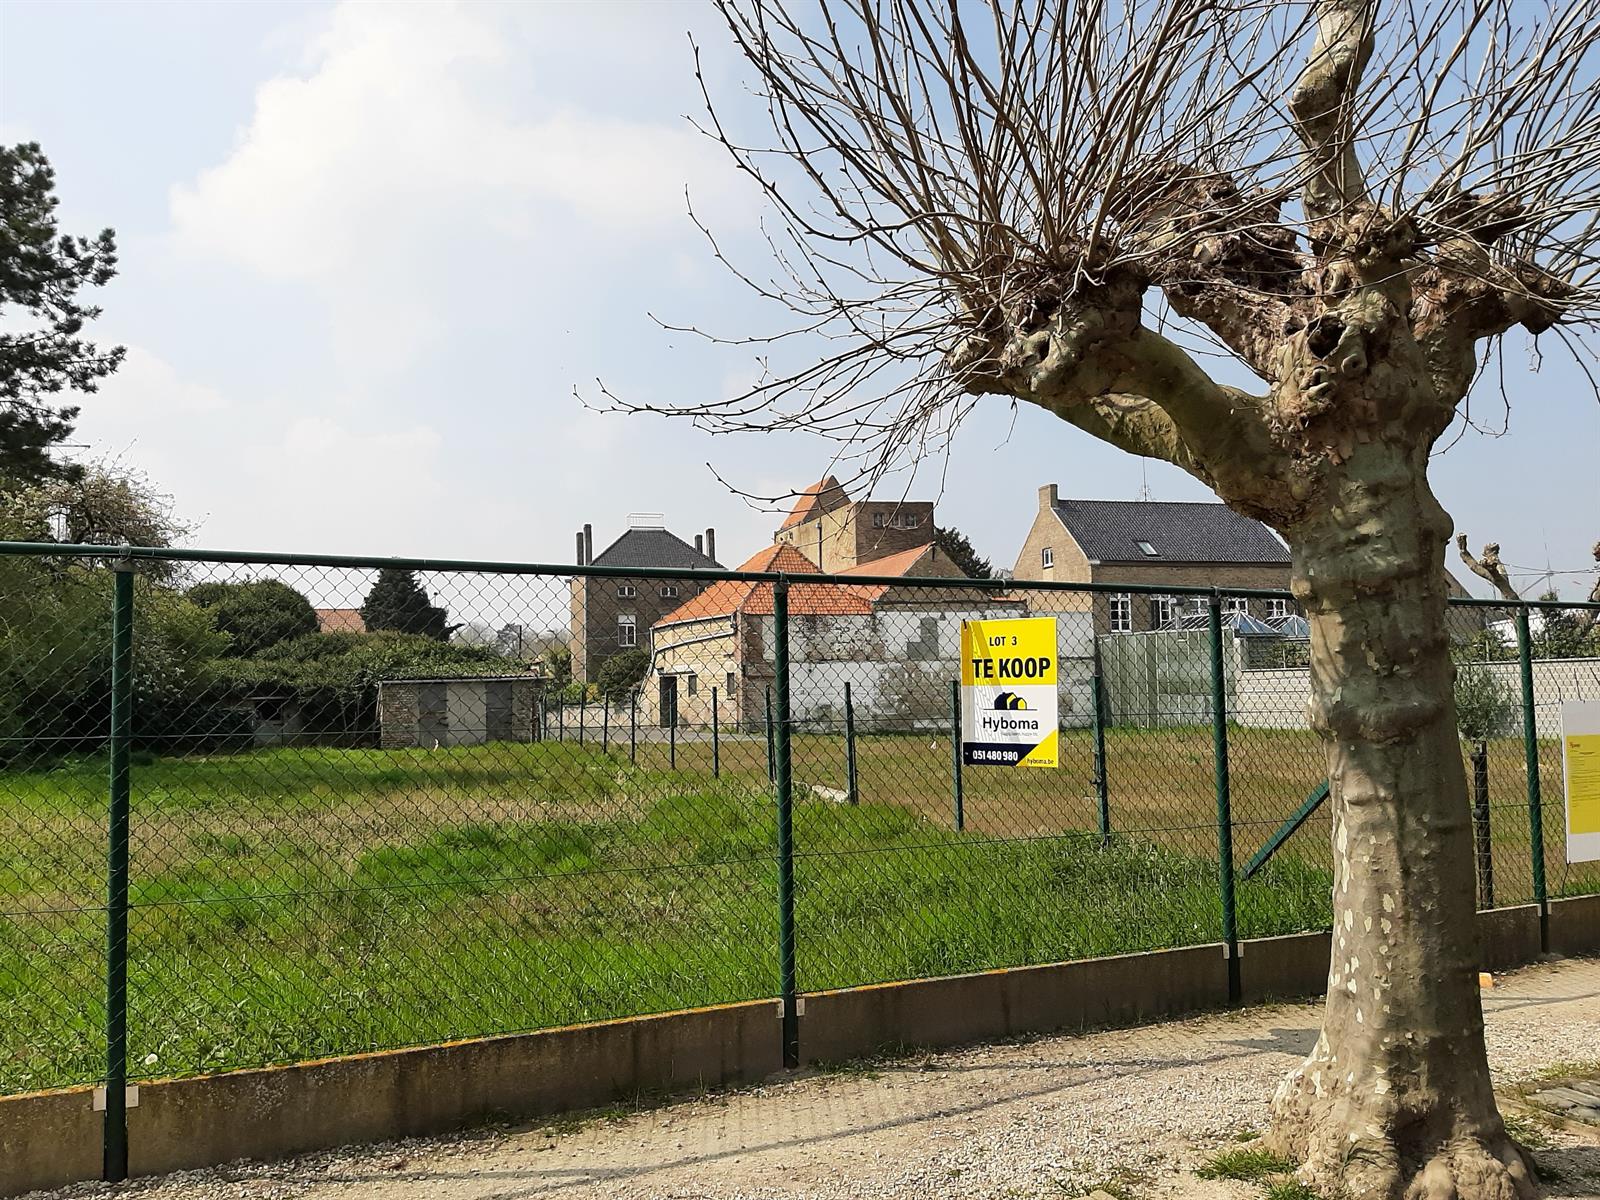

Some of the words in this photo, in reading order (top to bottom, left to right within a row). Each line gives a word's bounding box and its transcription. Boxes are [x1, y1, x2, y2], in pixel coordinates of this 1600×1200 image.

[989, 636, 1006, 647] LOT
[1011, 636, 1018, 646] 3
[972, 658, 994, 679] TE
[998, 657, 1051, 679] KOOP
[982, 717, 1039, 732] Hyboma
[972, 750, 986, 760] 051
[986, 750, 1002, 761] 480
[1002, 751, 1018, 761] 980
